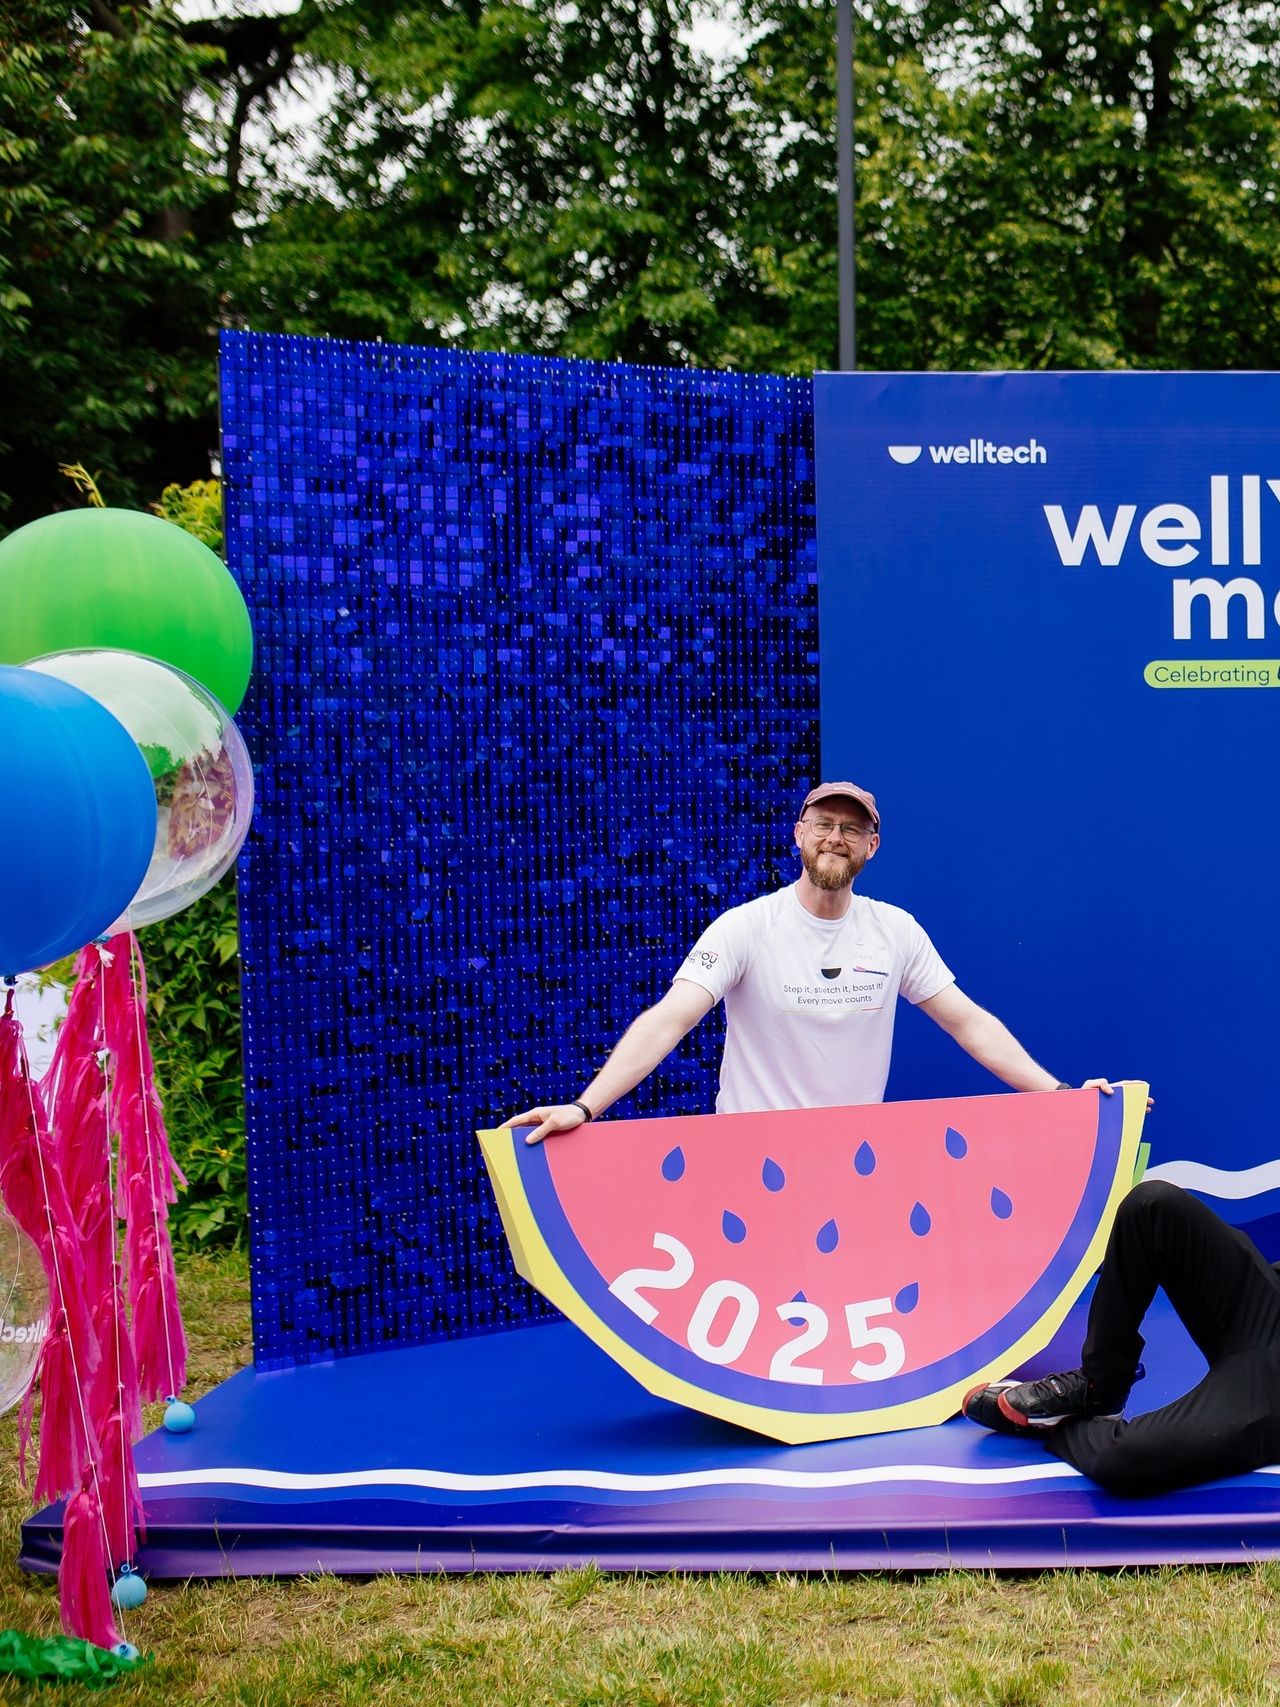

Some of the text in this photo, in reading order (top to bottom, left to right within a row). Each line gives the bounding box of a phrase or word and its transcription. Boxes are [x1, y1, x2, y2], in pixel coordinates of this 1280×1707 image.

[929, 438, 1047, 464] welltech
[1154, 665, 1270, 686] Celebrating
[783, 984, 803, 994] Step
[804, 986, 812, 994] it,
[814, 986, 840, 994] stretch
[842, 985, 851, 993] it,
[852, 983, 875, 992] boost
[797, 996, 819, 1005] Every
[844, 994, 872, 1003] counts
[608, 1233, 906, 1386] 2025
